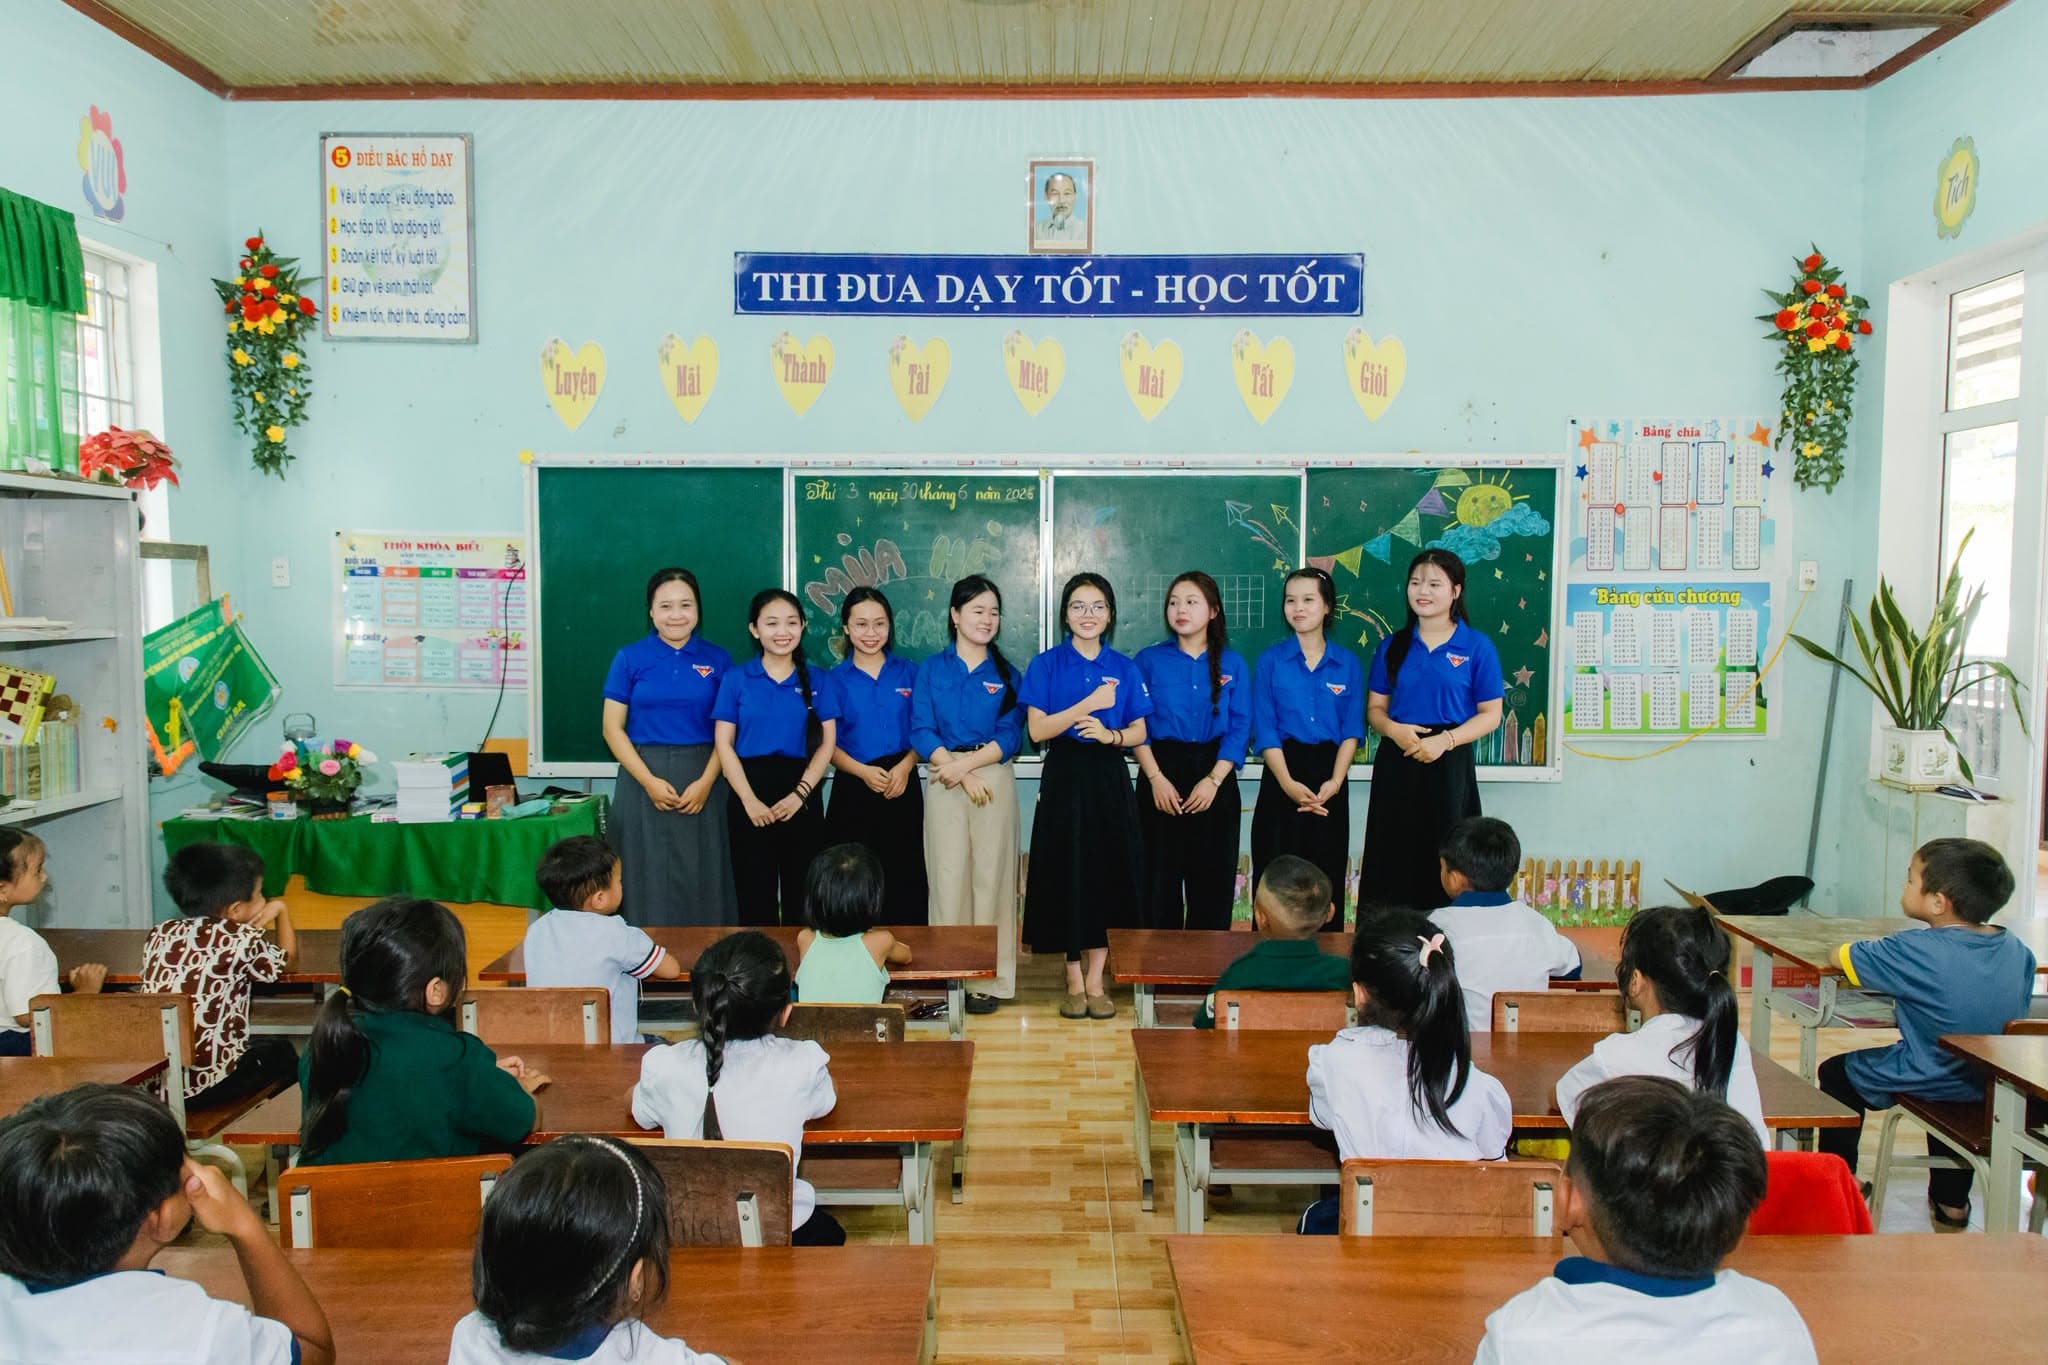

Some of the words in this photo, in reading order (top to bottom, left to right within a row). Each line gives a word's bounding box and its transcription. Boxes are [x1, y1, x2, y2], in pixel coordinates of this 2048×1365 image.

[334, 148, 348, 165] 5
[356, 145, 383, 166] ĐIỀU
[387, 149, 408, 166] BÁC
[412, 145, 427, 166] HỒ
[340, 188, 357, 204] Yêu
[753, 272, 827, 302] THI
[837, 274, 924, 303] ĐUA
[936, 274, 1023, 311] DẠY
[1035, 260, 1120, 304] TỐT
[1155, 274, 1248, 311] HỌC
[1259, 259, 1345, 304] TỐT
[555, 363, 597, 402] Luyện
[676, 364, 701, 397] Mãi
[783, 353, 826, 384] Thành
[908, 363, 930, 395] Tài
[1019, 359, 1049, 398] Miệt
[1138, 364, 1165, 399] Mài
[1251, 363, 1274, 398] Tất
[1360, 360, 1388, 397] Giỏi
[1643, 425, 1671, 438] Bảng
[1677, 426, 1701, 437] chia
[847, 482, 859, 499] 3
[899, 482, 918, 500] 30
[958, 484, 968, 500] 6
[1596, 585, 1641, 607] Bảng
[1643, 586, 1675, 605] cửu
[1678, 587, 1741, 607] chương
